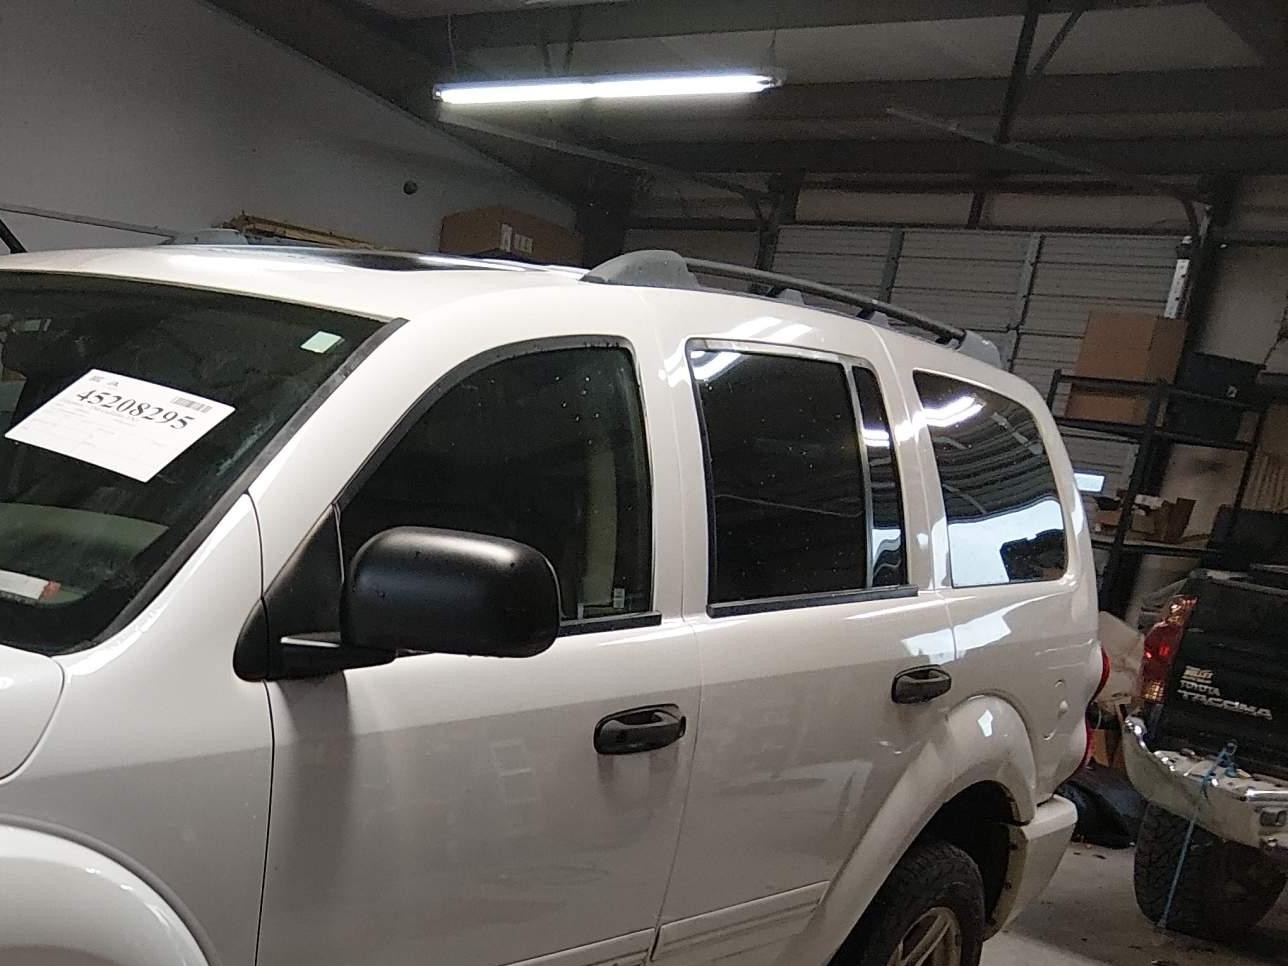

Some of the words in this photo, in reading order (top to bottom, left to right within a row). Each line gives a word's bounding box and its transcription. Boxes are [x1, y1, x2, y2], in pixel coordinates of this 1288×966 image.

[77, 389, 195, 430] 45208295
[1180, 680, 1221, 696] TOYOTA
[1177, 689, 1272, 720] TACOMA
